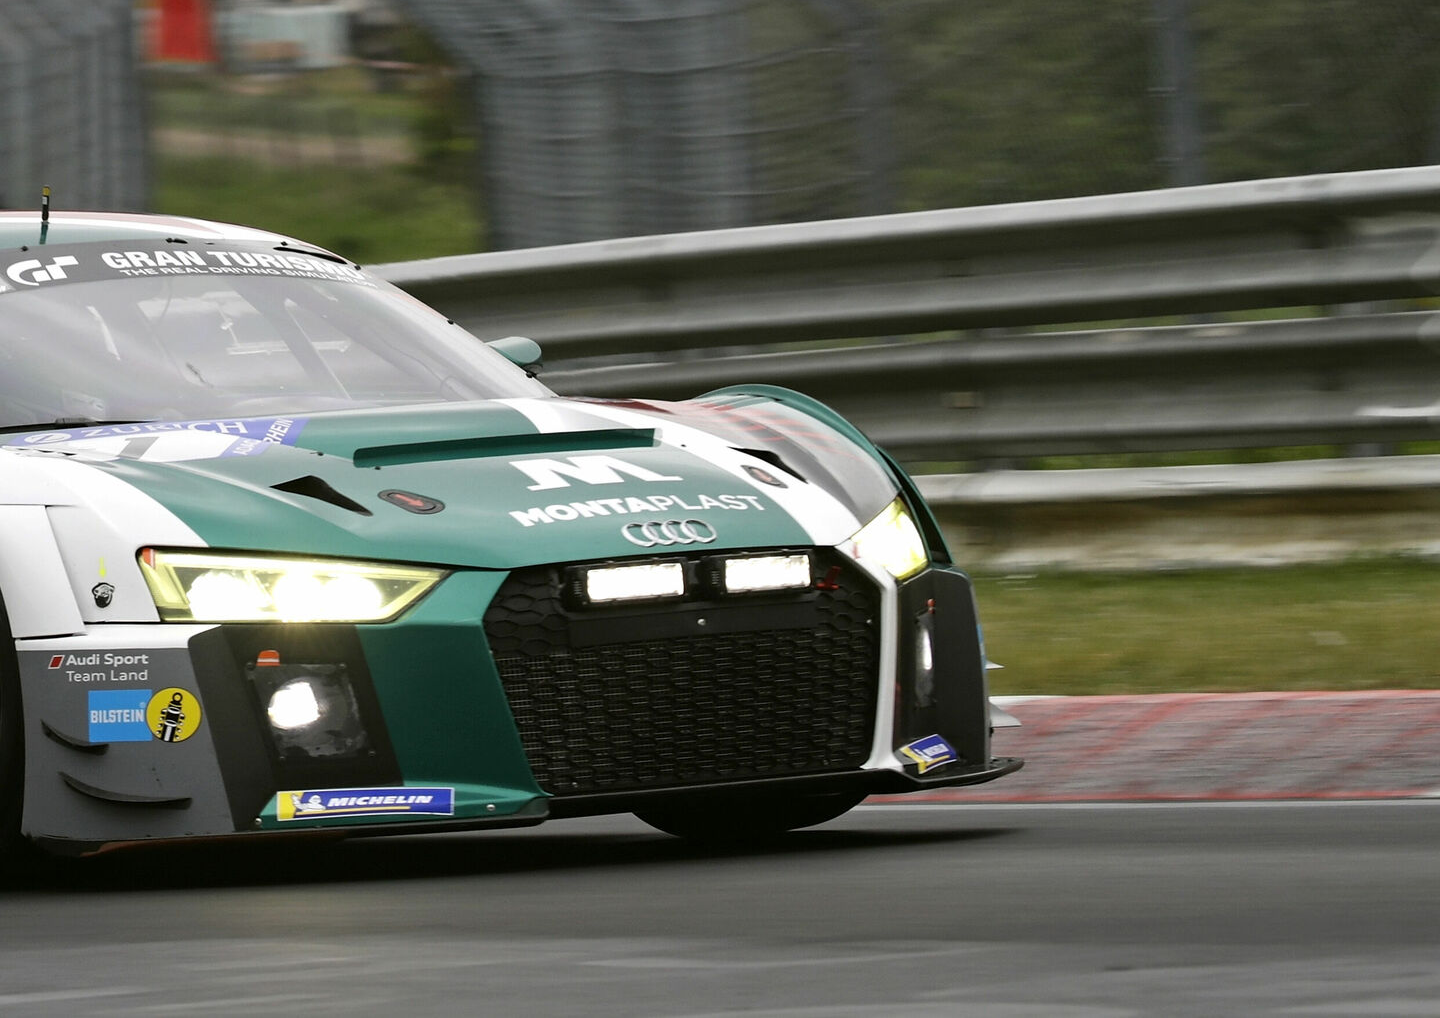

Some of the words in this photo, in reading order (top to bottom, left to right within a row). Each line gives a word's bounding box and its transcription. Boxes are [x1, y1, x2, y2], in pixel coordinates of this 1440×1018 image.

[101, 250, 206, 269] GRAN
[207, 251, 366, 280] TURISMO
[120, 268, 157, 277] THE
[160, 267, 203, 276] REAL
[206, 267, 281, 276] DRIVING
[85, 421, 248, 438] ZURICH
[509, 495, 766, 528] MONTAPLAST
[66, 654, 100, 666] Audi
[104, 653, 149, 667] Sport
[66, 670, 106, 682] Team
[110, 669, 148, 681] Land
[90, 709, 145, 724] BILSTEIN
[327, 793, 433, 807] MICHELIN
